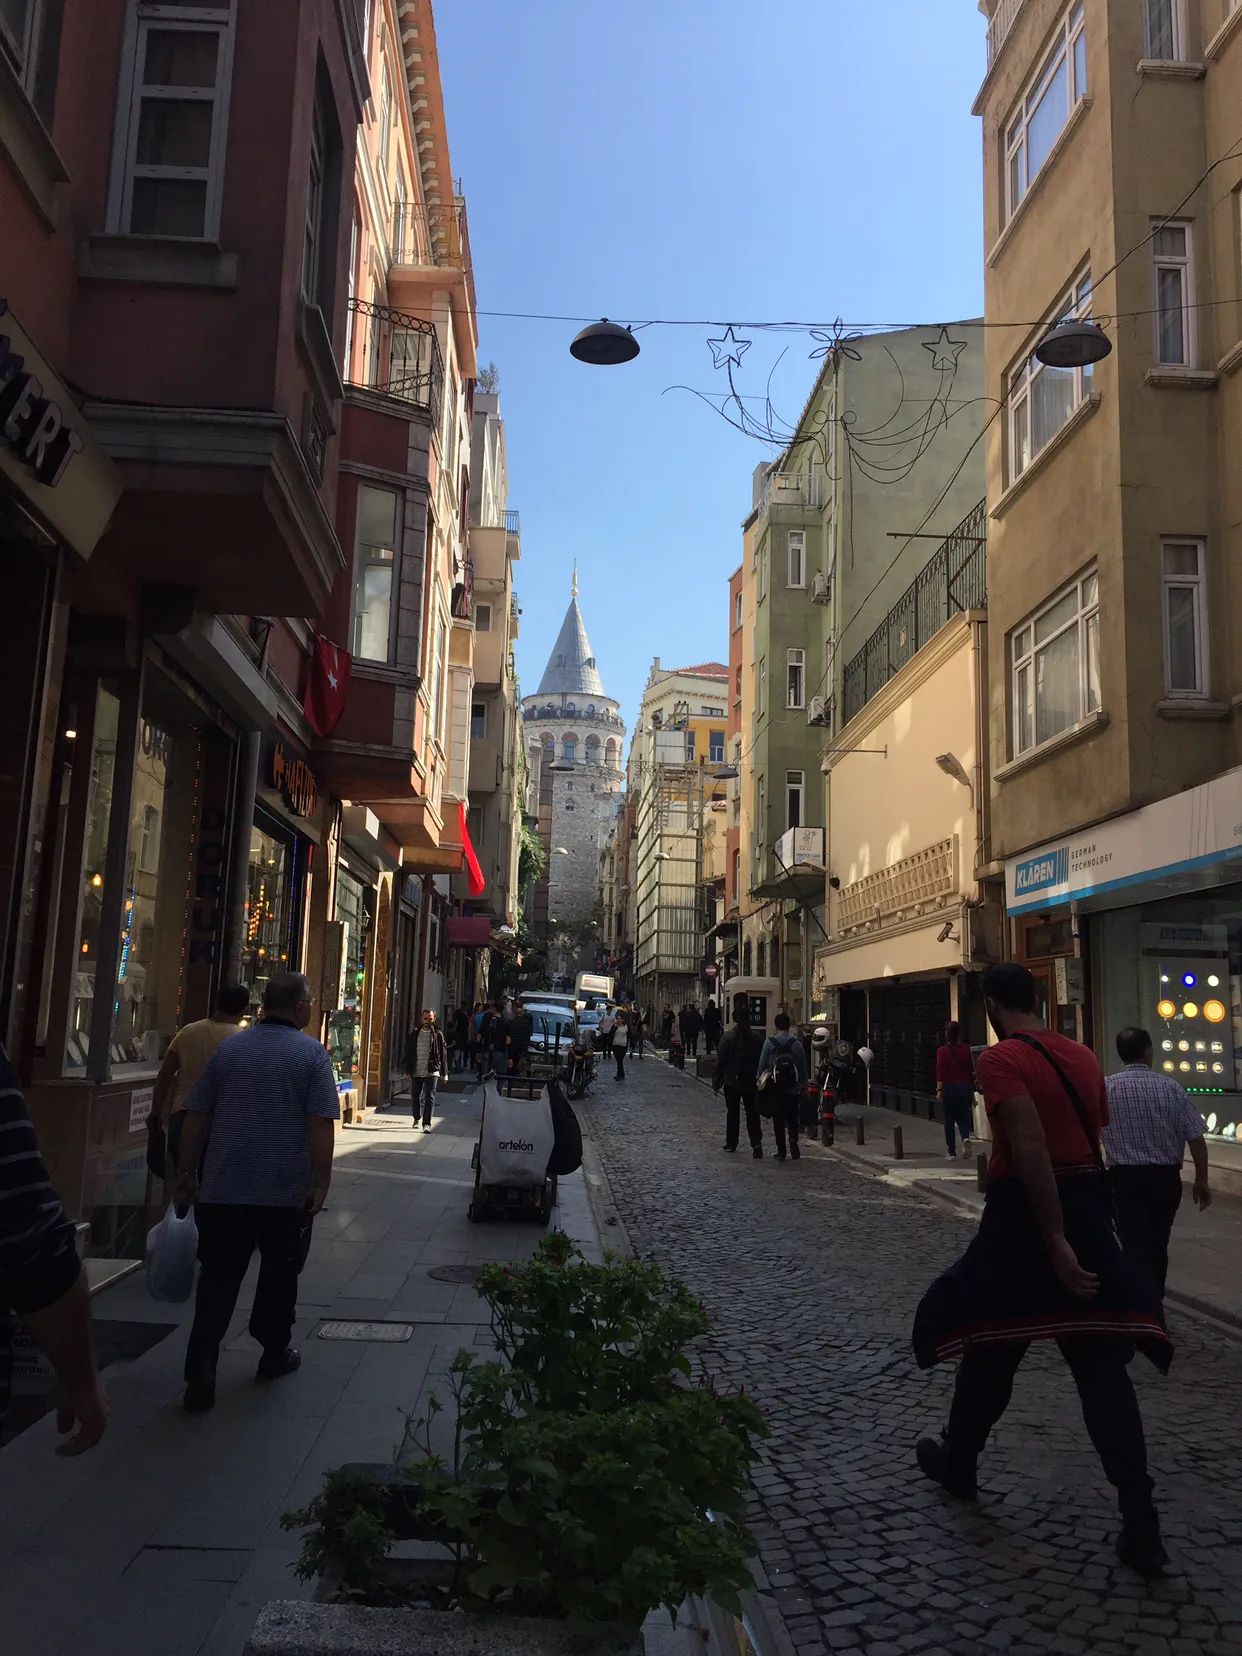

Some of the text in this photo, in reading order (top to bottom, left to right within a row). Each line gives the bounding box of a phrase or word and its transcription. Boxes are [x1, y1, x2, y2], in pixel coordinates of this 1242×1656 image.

[1071, 844, 1096, 859] GERMAN
[1072, 852, 1113, 872] TECHNOLOGY
[499, 1139, 534, 1152] artelon
